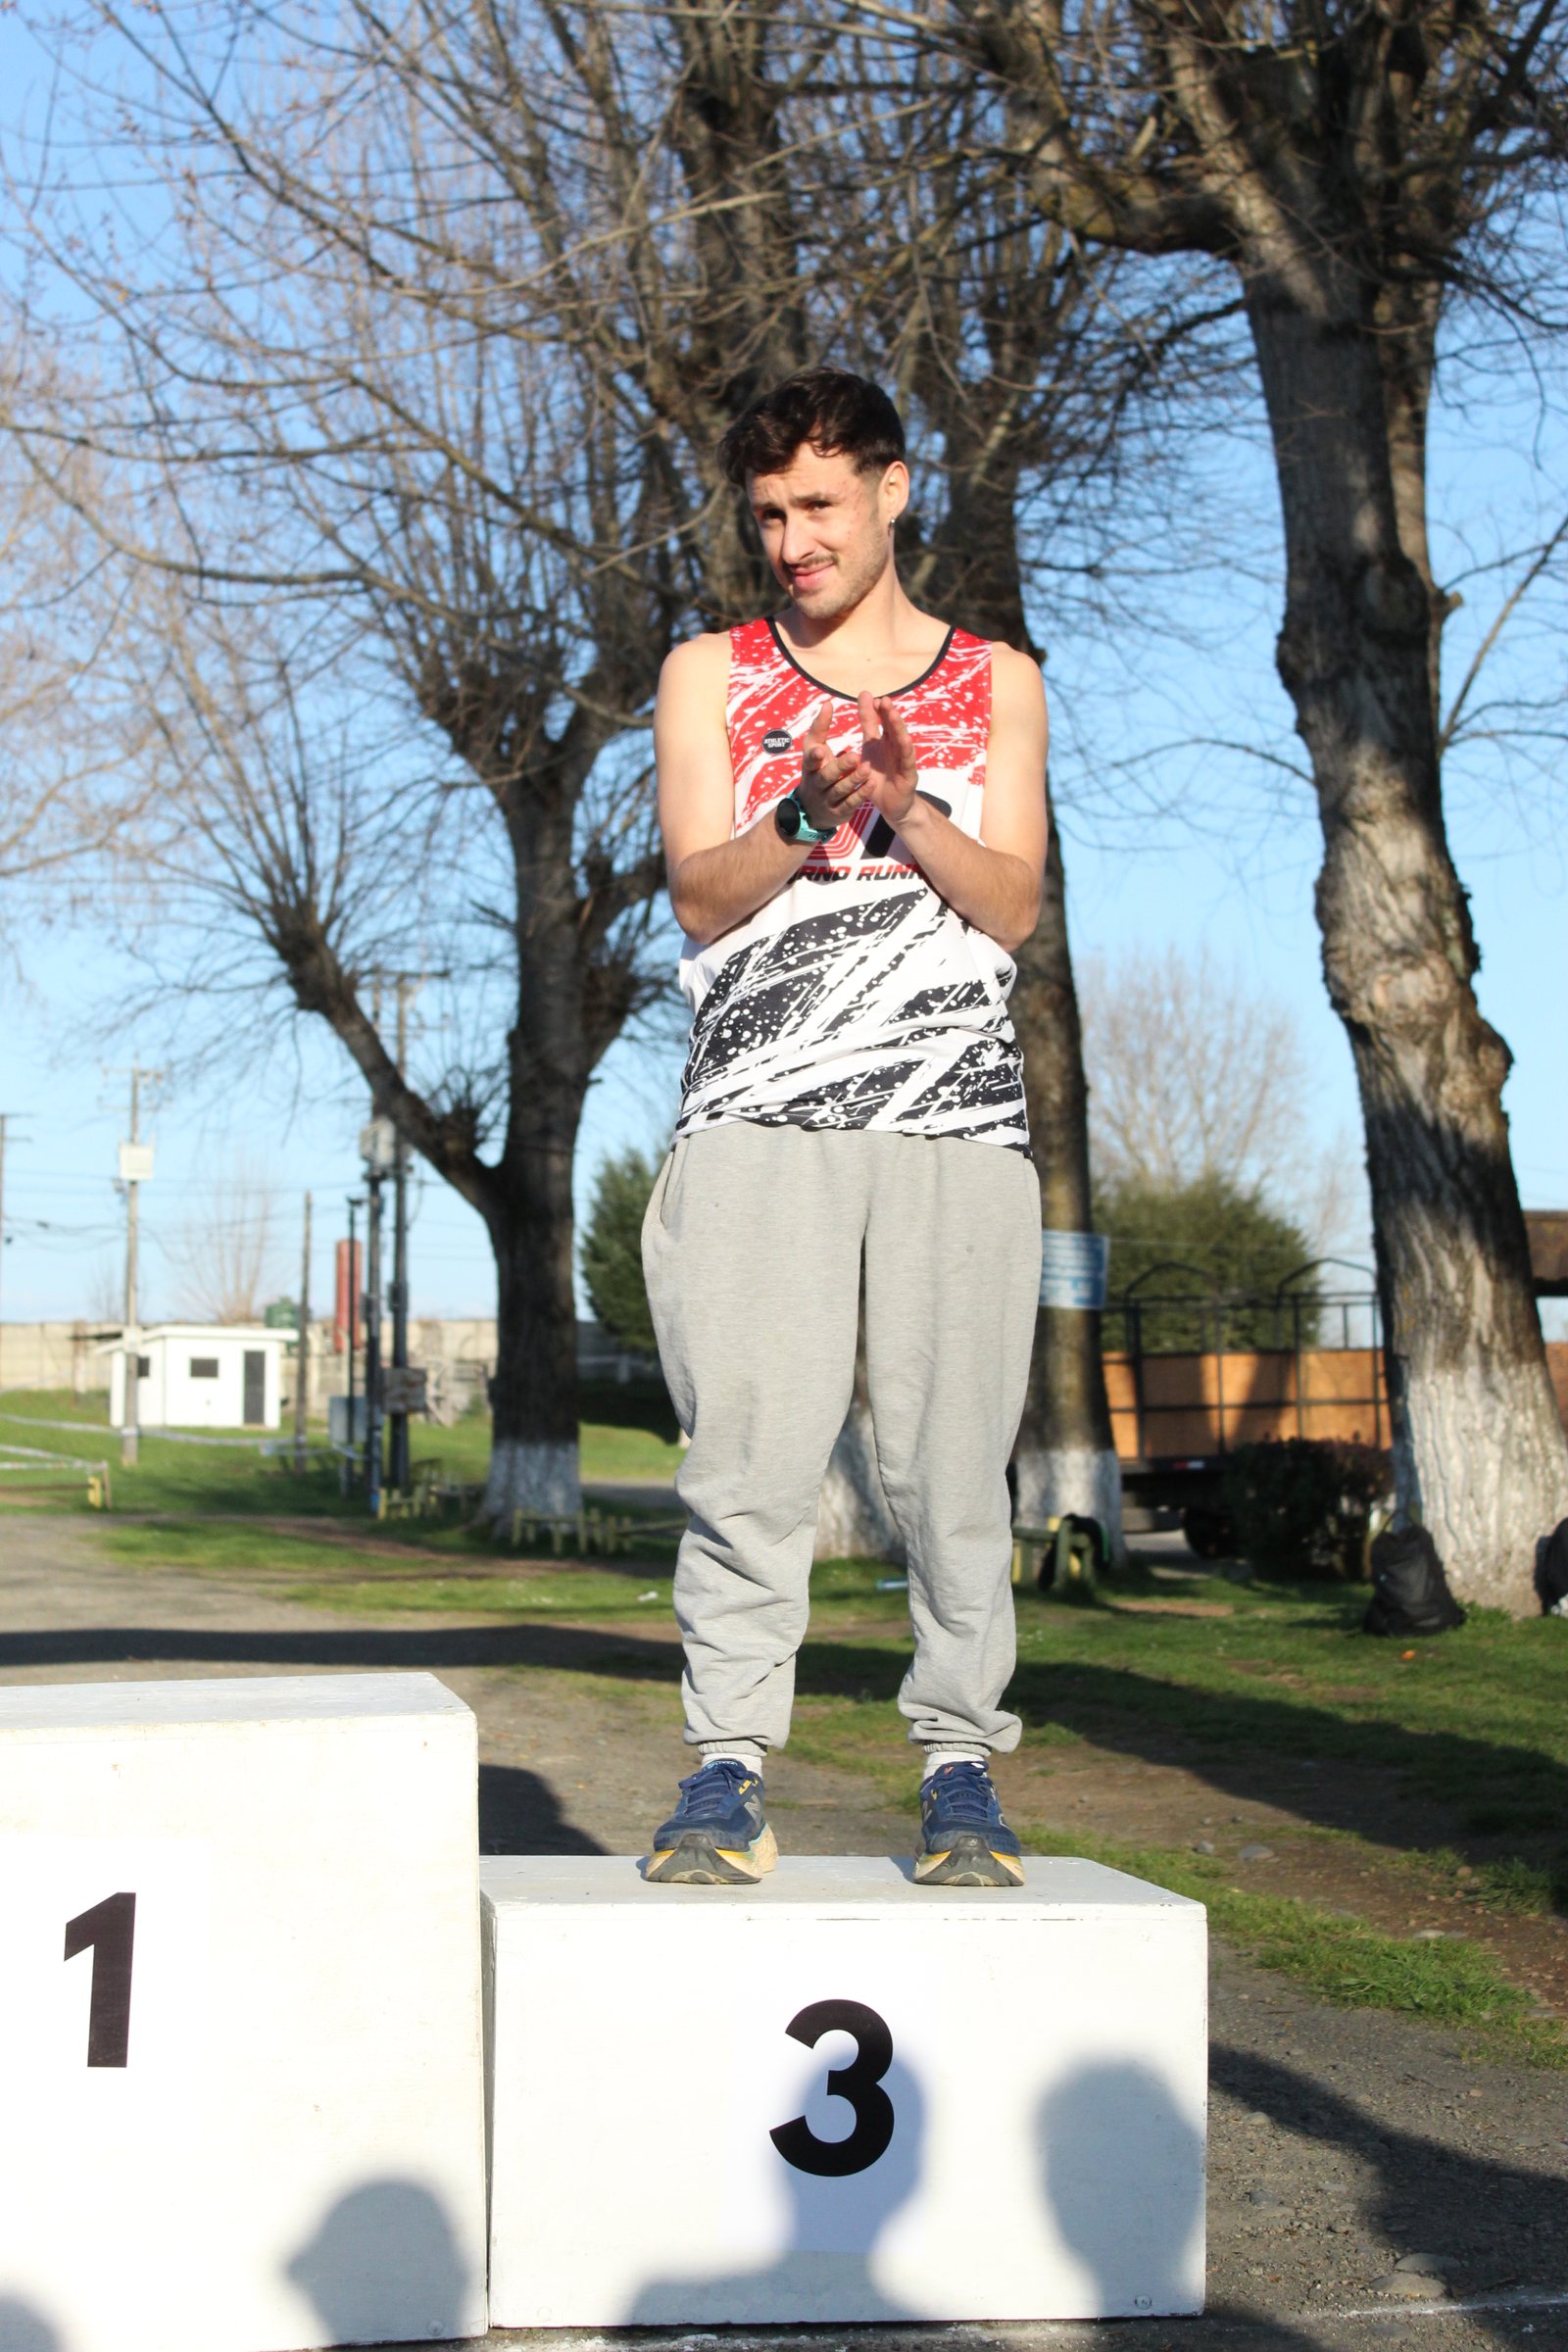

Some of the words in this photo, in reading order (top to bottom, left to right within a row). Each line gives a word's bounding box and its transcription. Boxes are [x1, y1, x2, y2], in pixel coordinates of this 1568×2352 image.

[787, 864, 852, 884] RNO
[64, 1891, 136, 2068] 1
[768, 1998, 895, 2178] 3
